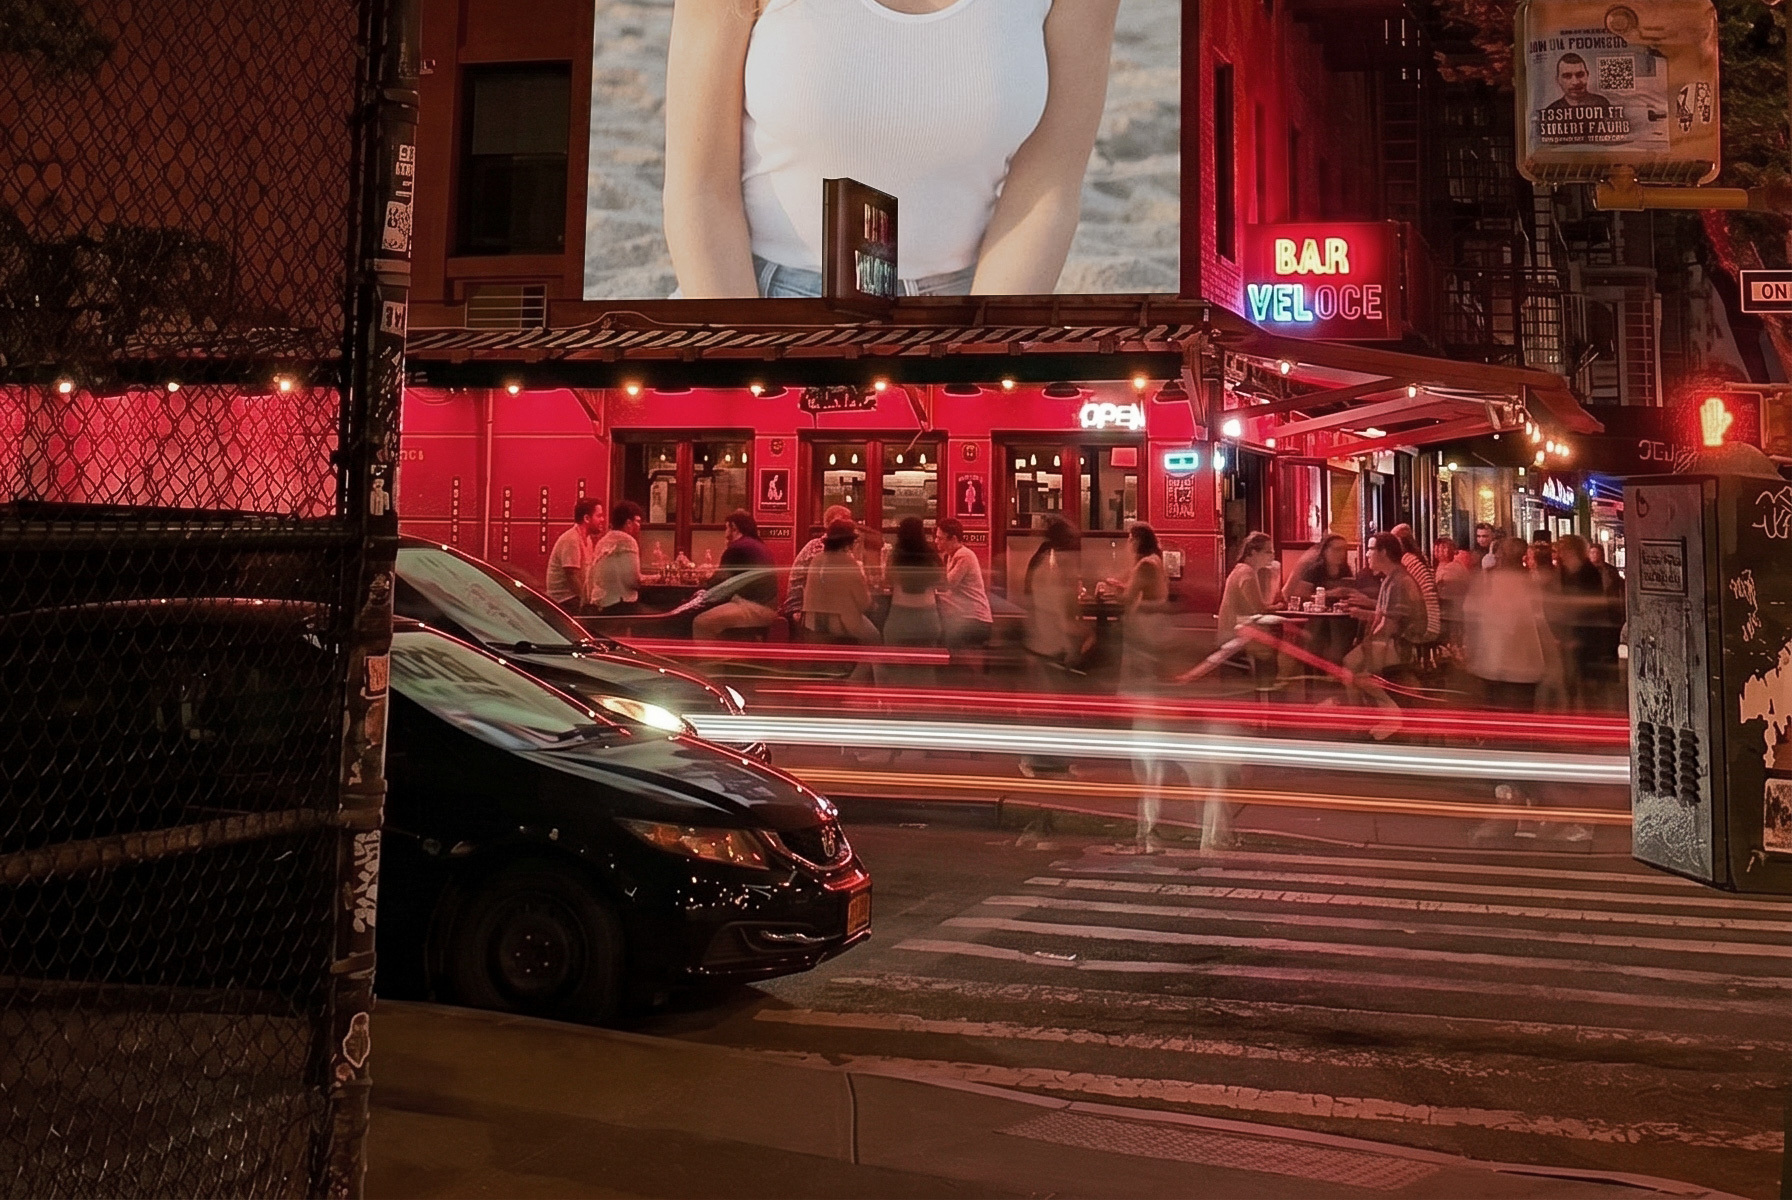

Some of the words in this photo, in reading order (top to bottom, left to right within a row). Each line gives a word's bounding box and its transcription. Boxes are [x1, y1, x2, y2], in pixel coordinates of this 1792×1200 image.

[1274, 237, 1350, 275] BAR
[1247, 283, 1383, 322] VELOCE
[1761, 283, 1792, 299] ON
[1079, 401, 1146, 430] OPEN
